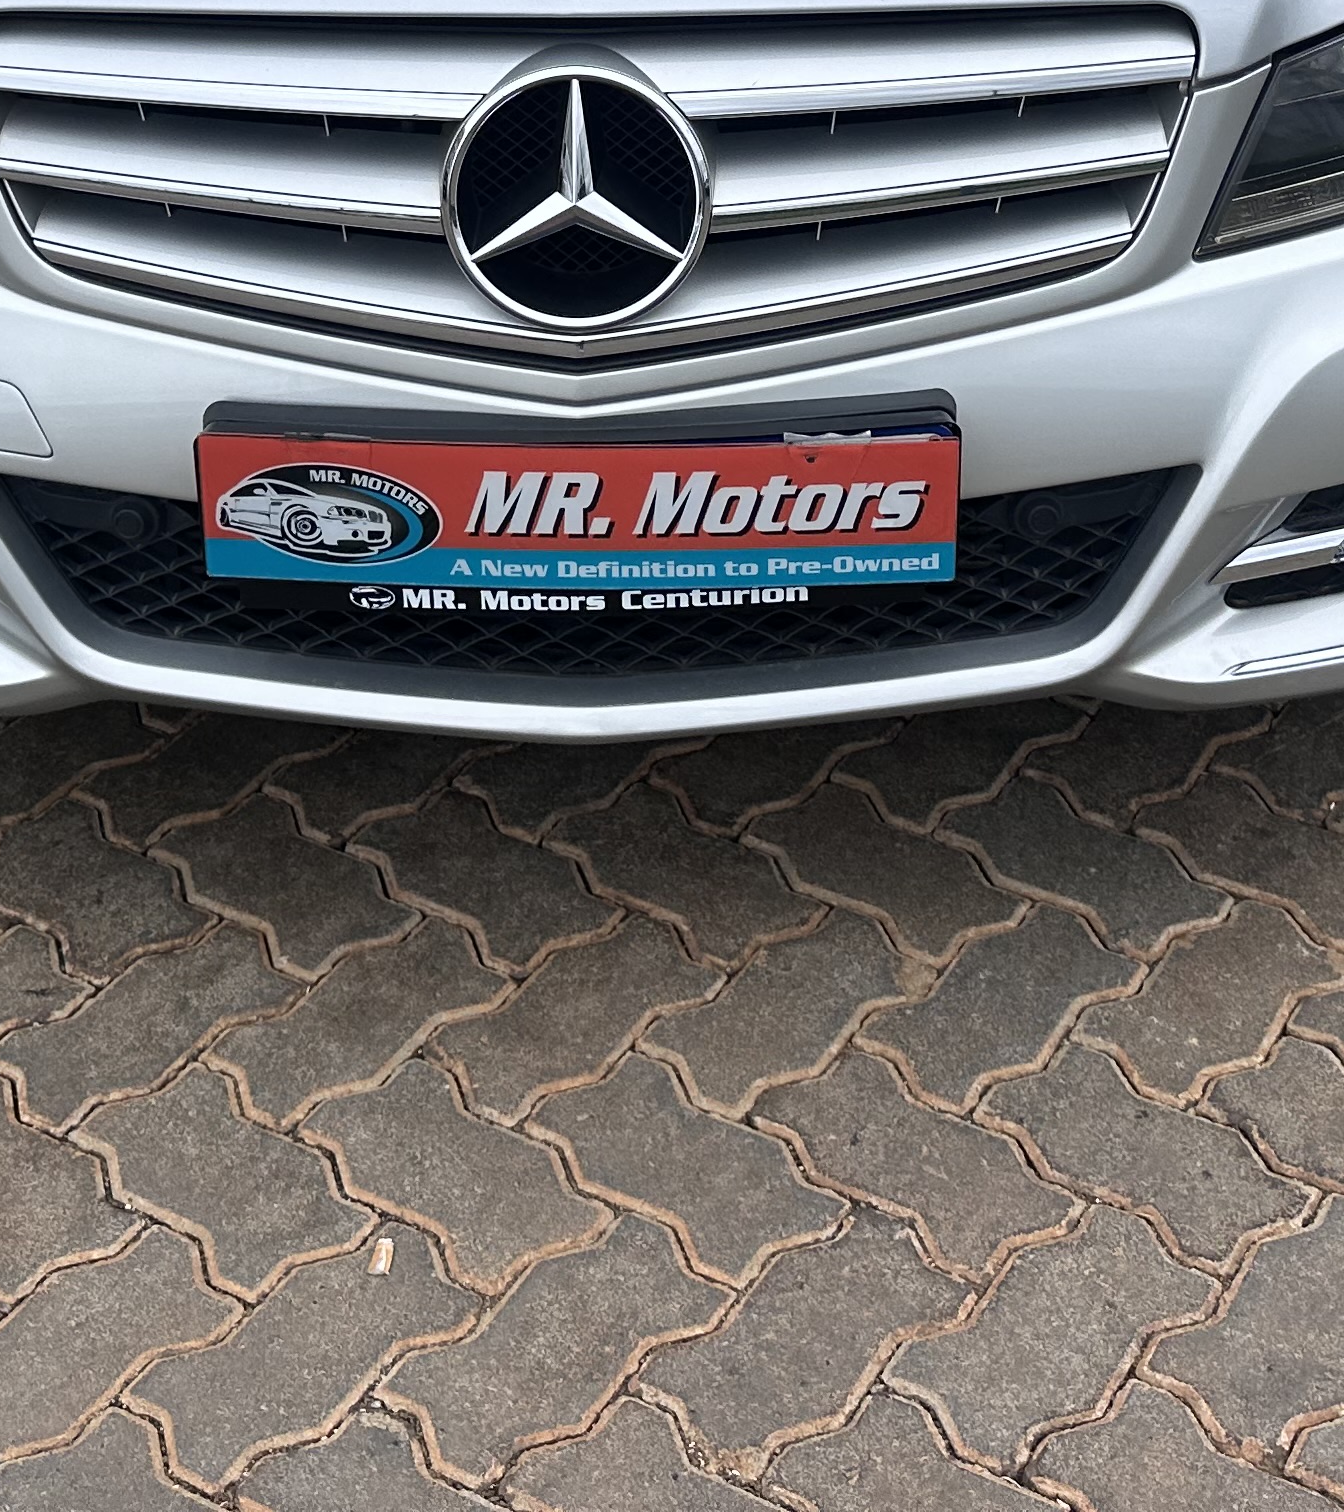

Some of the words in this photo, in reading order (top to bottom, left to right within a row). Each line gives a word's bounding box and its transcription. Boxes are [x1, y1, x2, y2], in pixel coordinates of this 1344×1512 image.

[309, 469, 346, 484] MR.
[351, 473, 429, 516] MOTORS
[464, 470, 613, 536] MR.
[632, 470, 928, 536] Motors
[450, 558, 472, 576] A
[481, 559, 548, 577] New
[557, 560, 716, 578] Definition
[724, 560, 759, 576] to
[767, 552, 940, 576] Pre-Owned
[402, 588, 466, 610] MR.
[480, 589, 606, 611] Motors
[621, 586, 809, 611] Centurion
